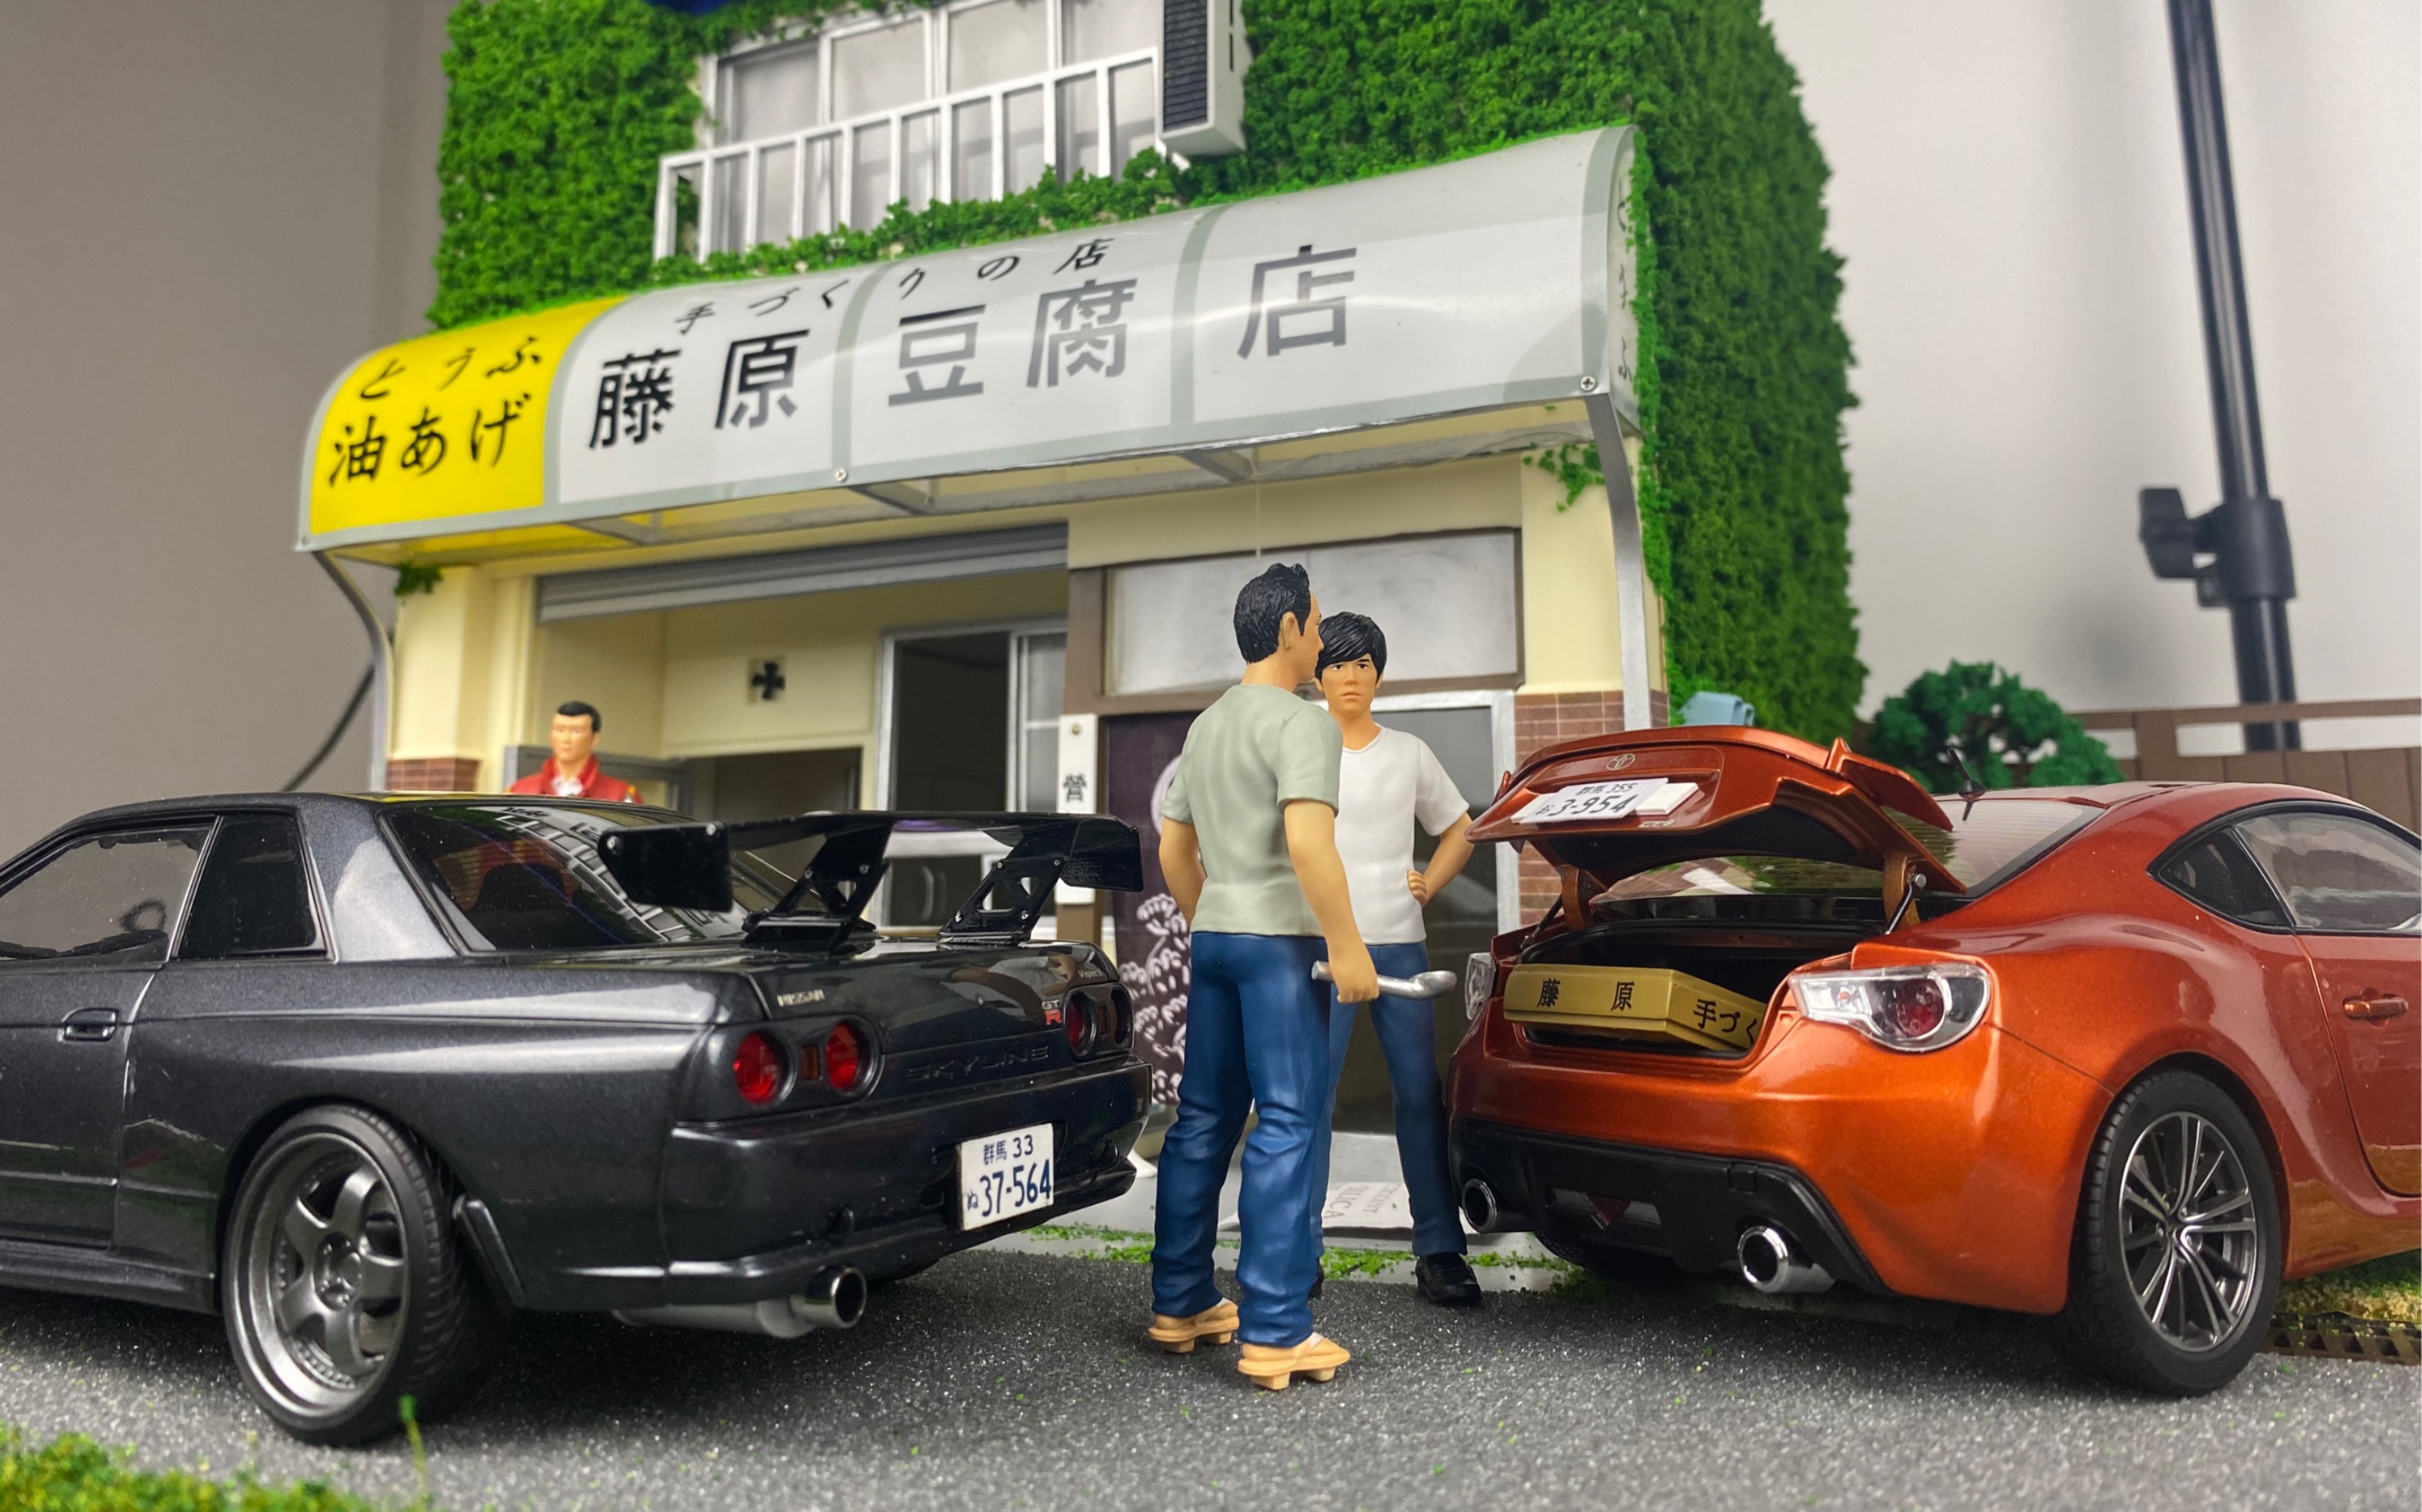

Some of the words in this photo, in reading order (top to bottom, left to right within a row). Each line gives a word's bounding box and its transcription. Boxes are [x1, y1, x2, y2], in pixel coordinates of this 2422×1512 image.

[674, 238, 1115, 335] 手づくりの店
[359, 335, 543, 400] とうふ
[588, 244, 1358, 450] 藤原豆腐店
[329, 392, 532, 487] 油あげ
[1547, 794, 1638, 817] 3-954
[1606, 782, 1638, 794] 355
[984, 1140, 1007, 1165] 群馬
[1013, 1134, 1033, 1158] 33
[979, 1158, 1051, 1217] 37-564
